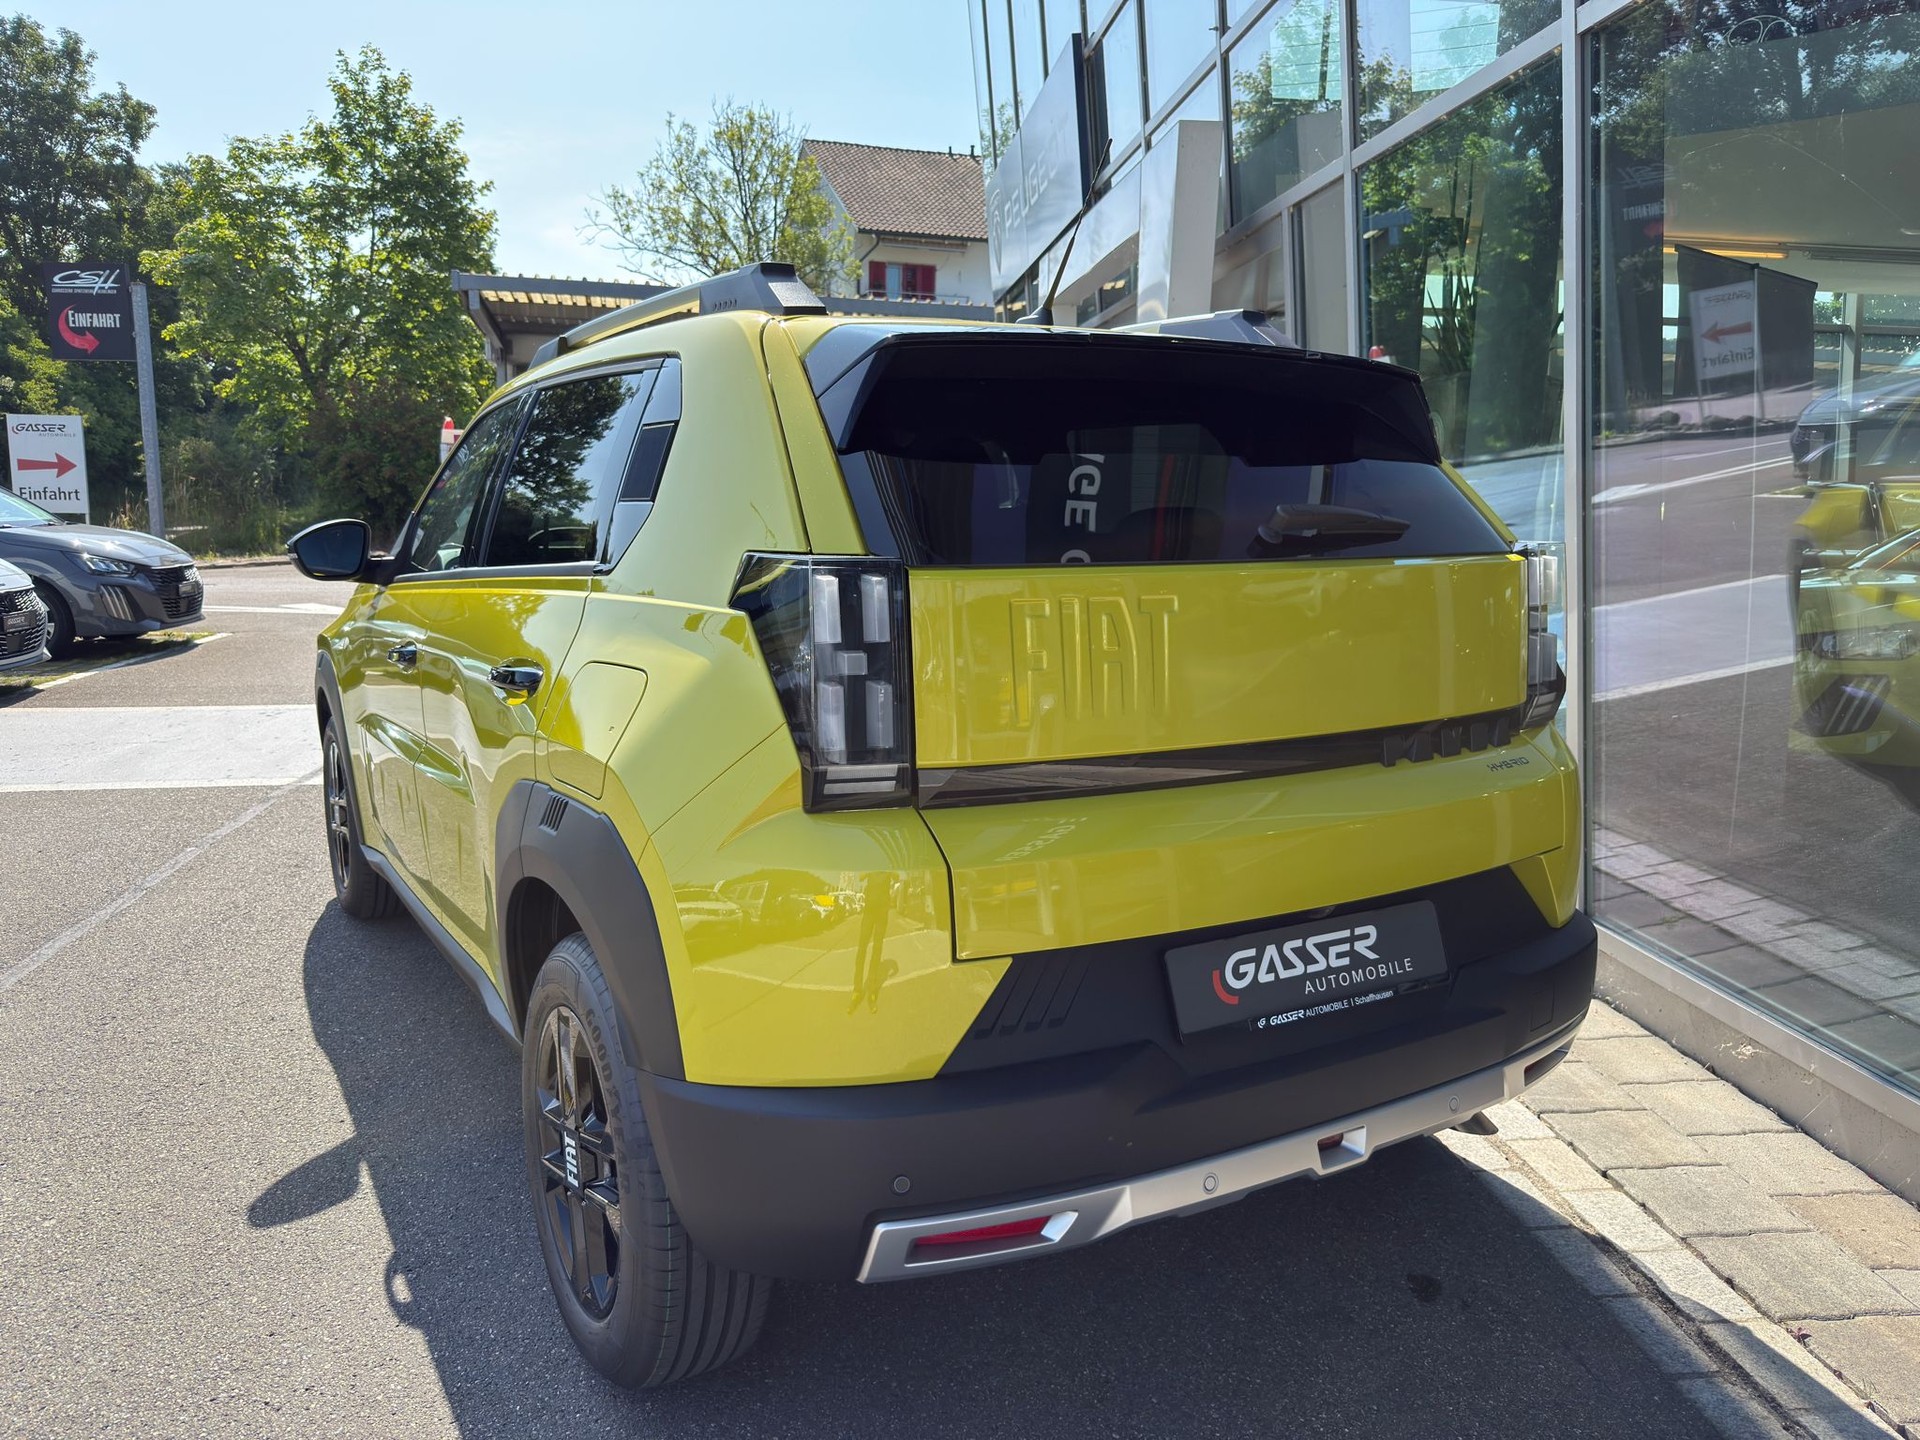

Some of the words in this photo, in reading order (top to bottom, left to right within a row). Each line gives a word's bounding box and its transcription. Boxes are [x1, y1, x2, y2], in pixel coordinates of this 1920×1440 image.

[68, 310, 120, 328] EINFAHRT
[15, 423, 66, 433] GASSER
[19, 487, 81, 501] Einfahrt
[1009, 594, 1178, 727] FIAT
[1487, 755, 1530, 773] HYBRID
[1224, 925, 1380, 990] GASSER
[1304, 957, 1414, 995] AUTOMOBILE
[1269, 1010, 1305, 1026] GASSER
[1305, 999, 1349, 1018] AUTOMOBILE
[1354, 990, 1394, 1006] Schaffhausen
[564, 1131, 579, 1188] FIAT
